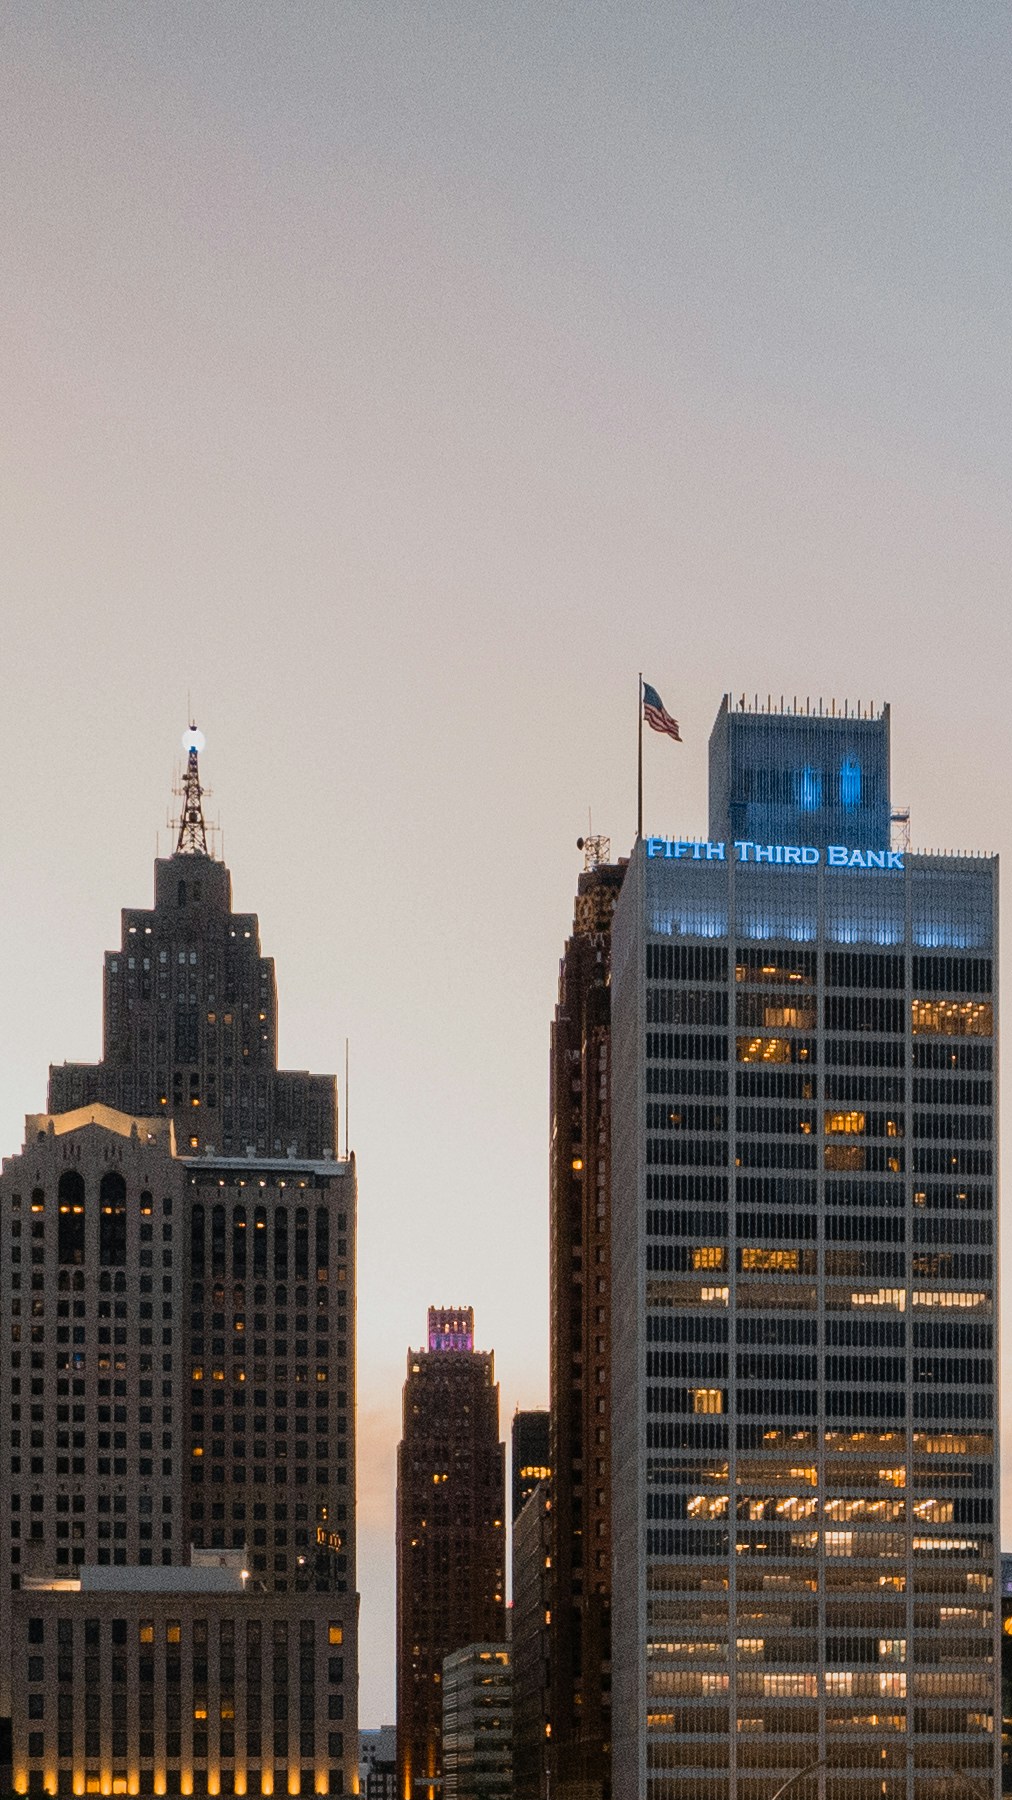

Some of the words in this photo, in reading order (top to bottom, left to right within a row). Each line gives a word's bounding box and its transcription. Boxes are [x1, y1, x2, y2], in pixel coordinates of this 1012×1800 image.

[647, 837, 725, 860] FIFTH
[734, 841, 820, 866] THIRD
[827, 845, 905, 869] BANK
